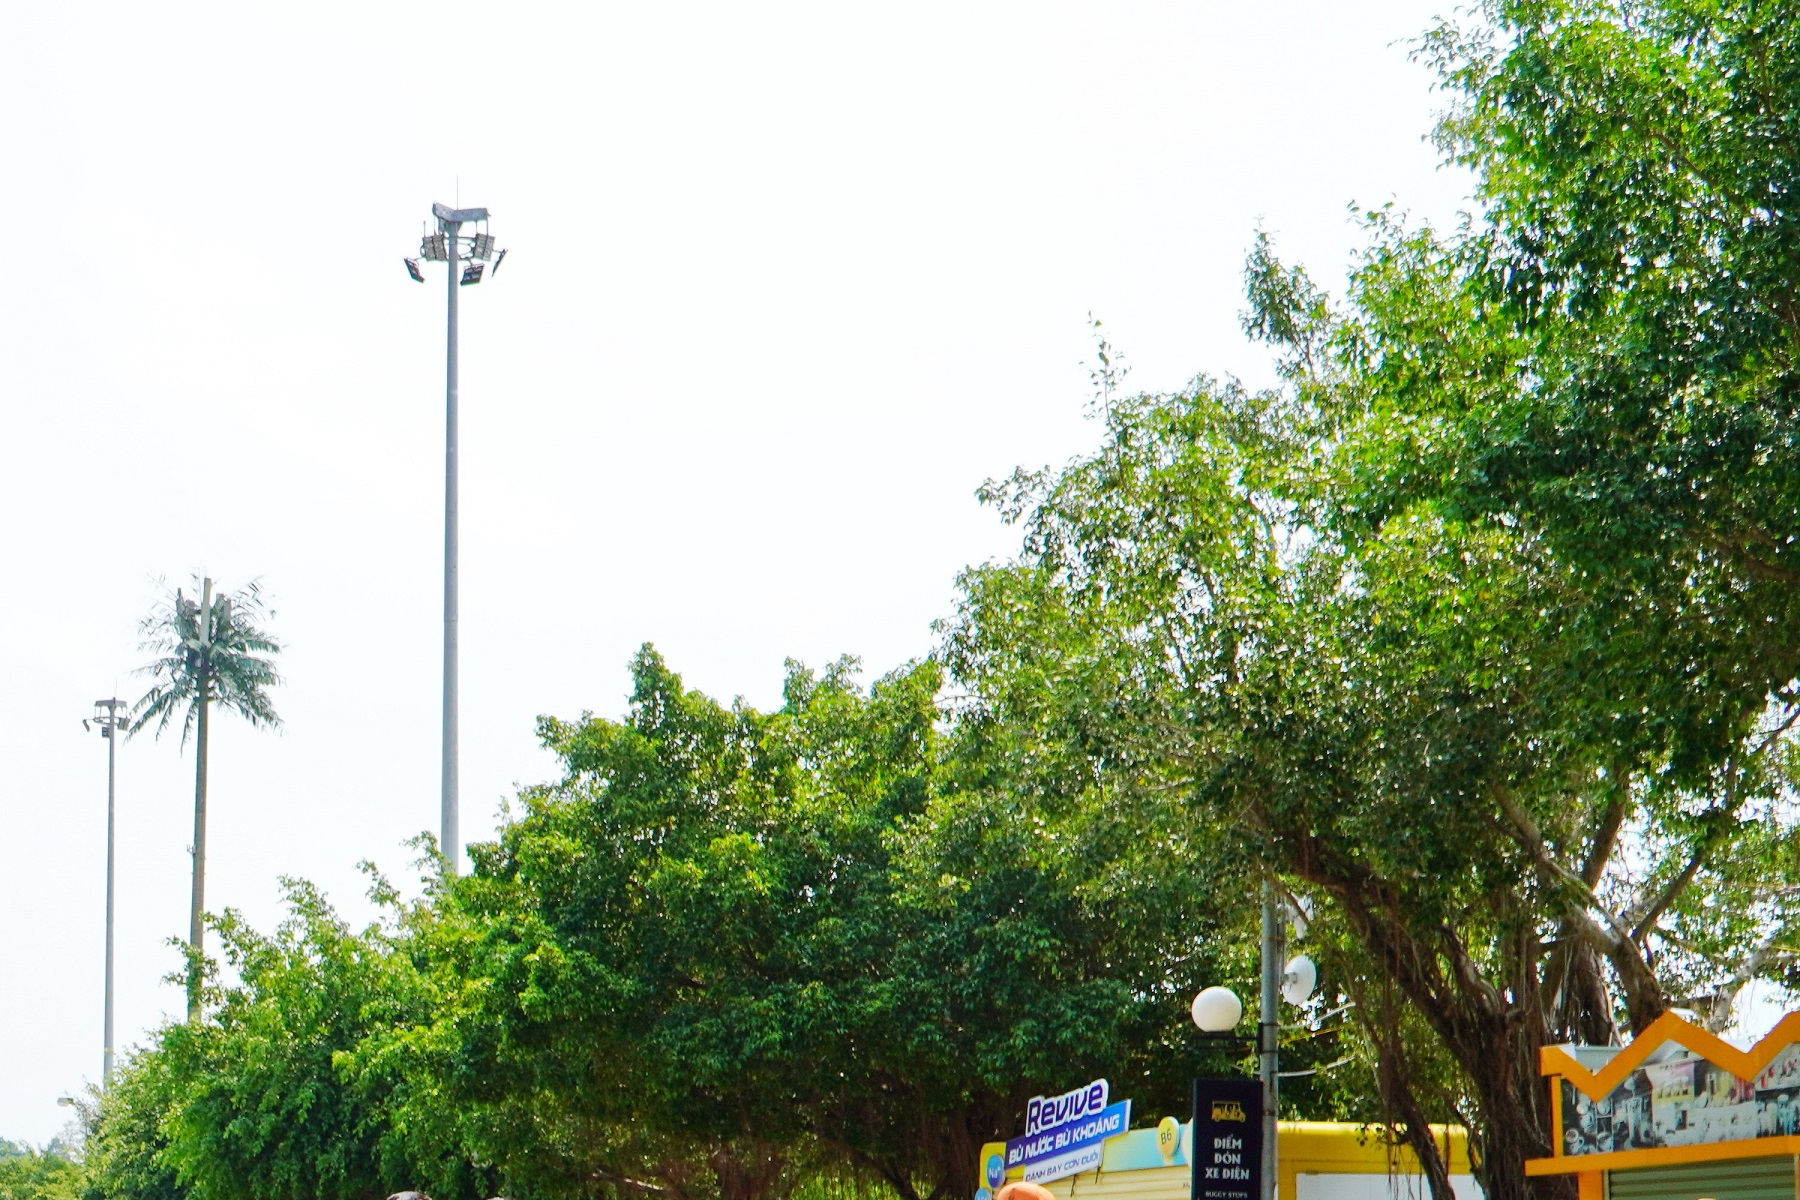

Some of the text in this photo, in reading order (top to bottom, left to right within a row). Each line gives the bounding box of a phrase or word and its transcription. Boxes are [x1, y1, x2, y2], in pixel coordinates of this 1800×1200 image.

[1028, 1083, 1104, 1133] Revive
[1008, 1113, 1120, 1165] BÙ NƯỚC BÙ KHOÁNG
[1161, 1130, 1172, 1145] B6
[1214, 1134, 1242, 1150] ĐIỂM
[1214, 1151, 1241, 1165] ĐÓN
[1047, 1163, 1062, 1176] BAY
[1205, 1166, 1250, 1181] XE ĐIỆN
[1228, 1191, 1248, 1199] STOPS
